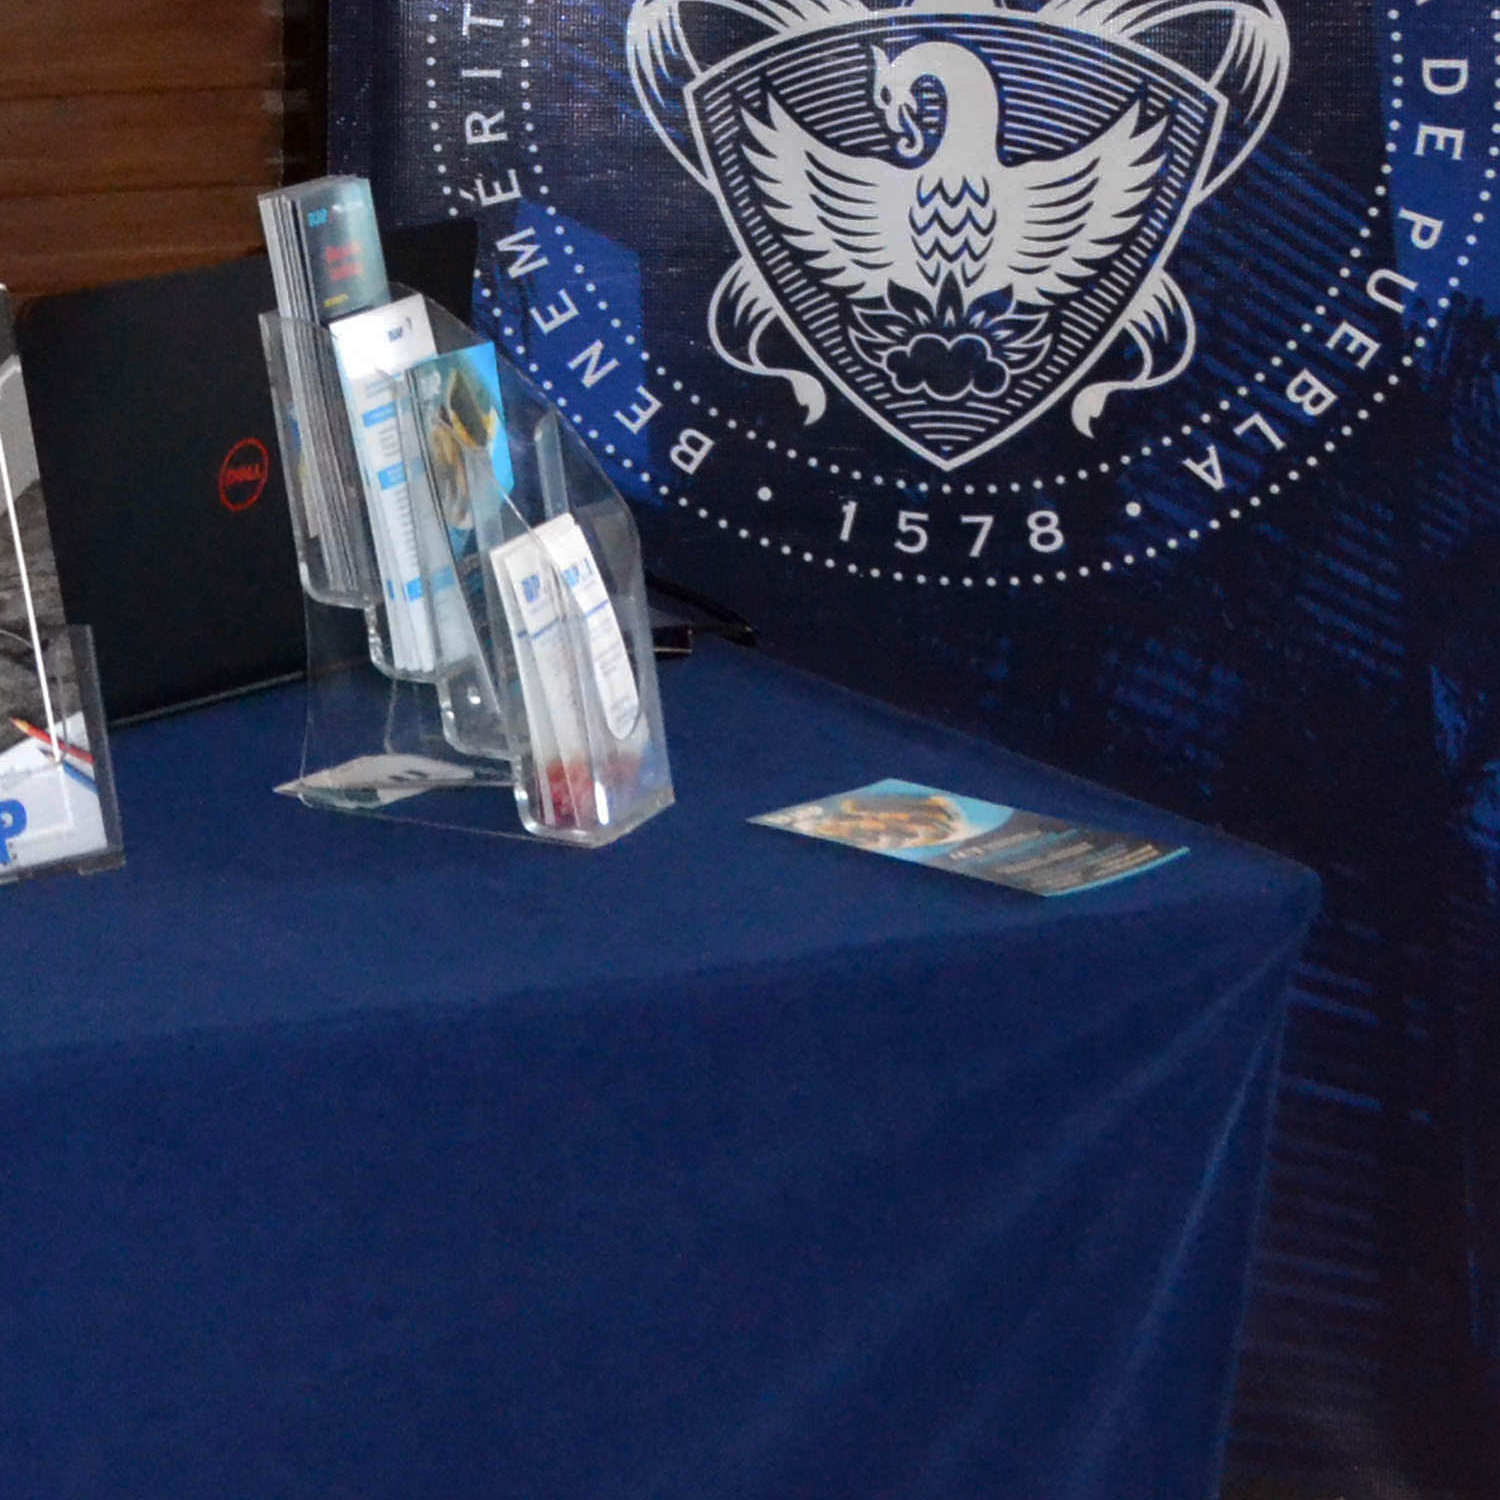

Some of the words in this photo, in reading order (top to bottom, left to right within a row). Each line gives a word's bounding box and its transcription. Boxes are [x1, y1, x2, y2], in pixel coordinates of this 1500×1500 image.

[1413, 57, 1469, 161] DE
[1182, 207, 1444, 493] PUEBLA
[837, 499, 1065, 558] 1578
